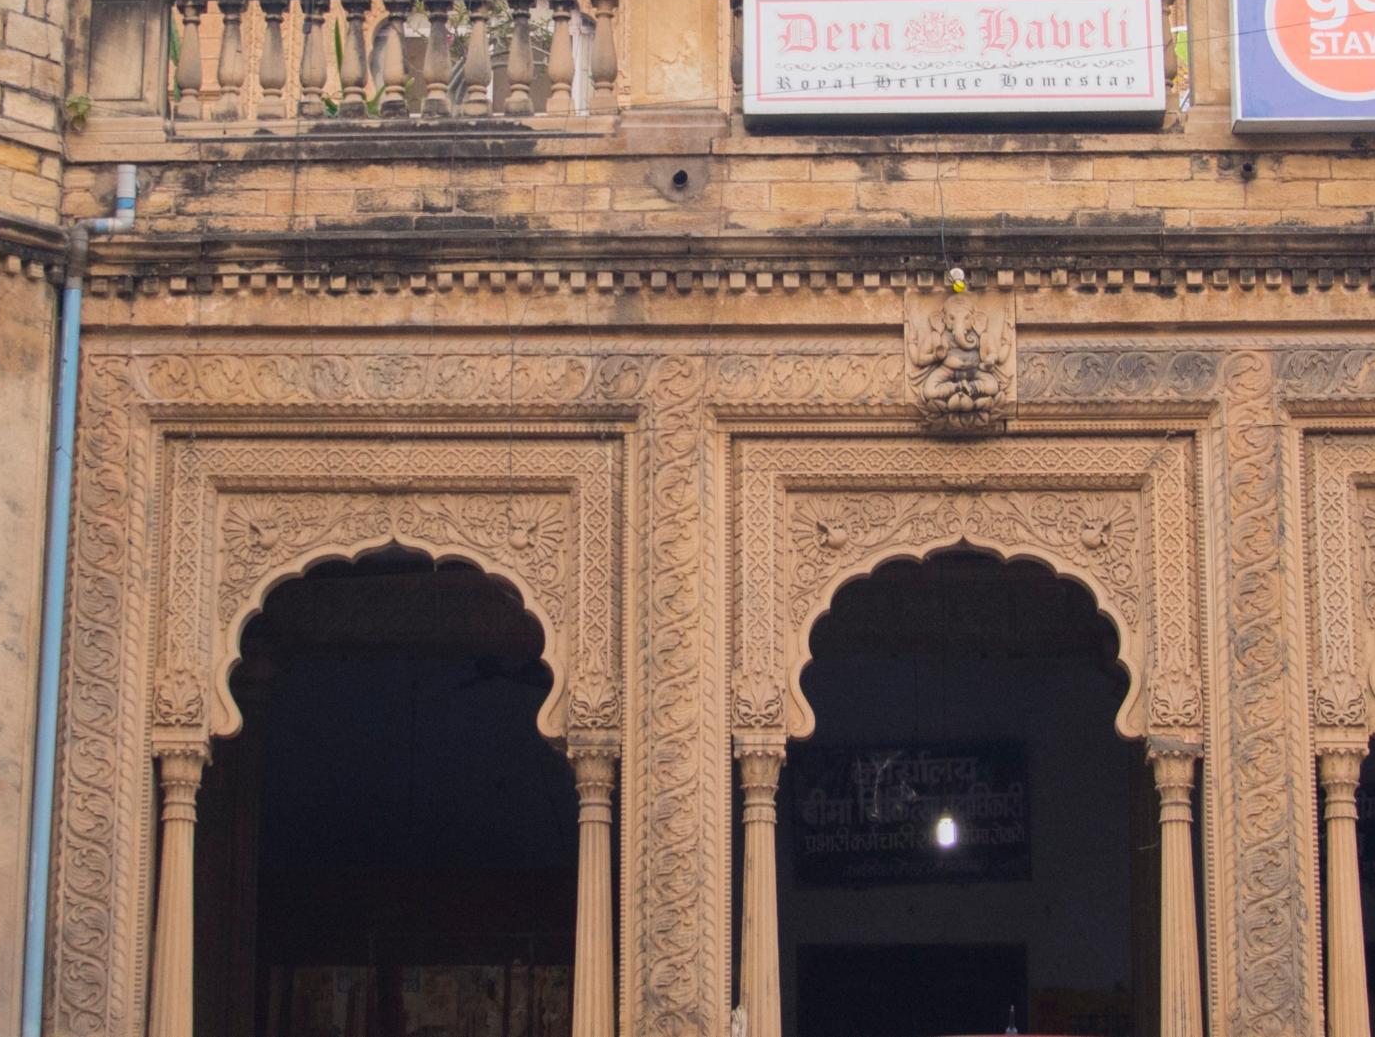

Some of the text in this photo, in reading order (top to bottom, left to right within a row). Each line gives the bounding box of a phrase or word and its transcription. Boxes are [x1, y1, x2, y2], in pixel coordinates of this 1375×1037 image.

[777, 6, 1132, 57] Dera Haveli
[776, 74, 856, 91] Royal
[1000, 73, 1136, 90] Homestay
